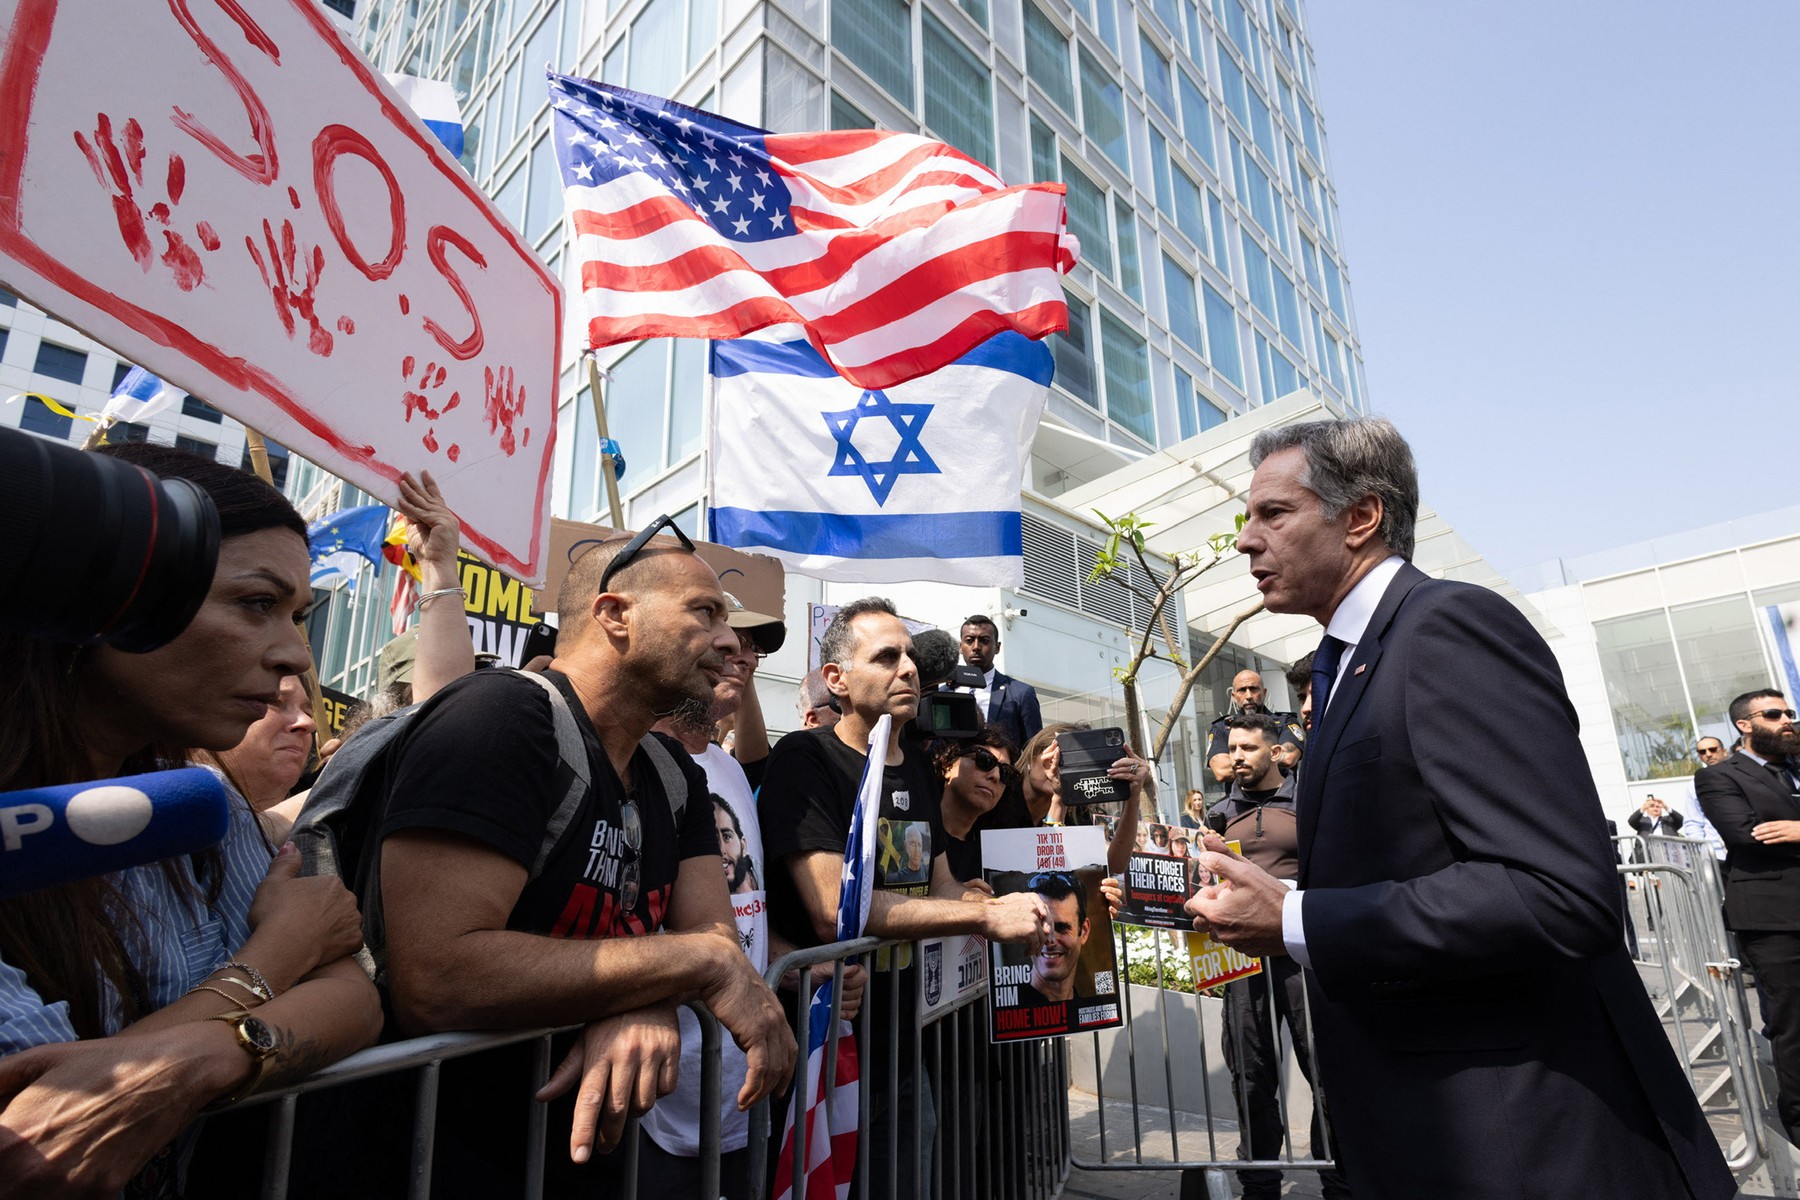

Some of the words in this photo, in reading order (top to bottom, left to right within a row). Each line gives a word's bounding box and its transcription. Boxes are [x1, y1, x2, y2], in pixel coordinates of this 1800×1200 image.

[813, 605, 831, 627] Pr
[591, 819, 625, 858] BNG
[1036, 845, 1055, 857] DROR
[1055, 844, 1065, 856] OR
[583, 848, 620, 890] THM
[1052, 856, 1066, 869] (49)
[1129, 856, 1153, 874] DON'T
[1154, 859, 1184, 877] FORGET
[1129, 872, 1156, 890] THEIR
[1157, 874, 1185, 893] FACES
[995, 964, 1031, 986] BRING
[1194, 951, 1224, 983] FOR
[1222, 947, 1257, 974] YOU
[995, 986, 1019, 1008] HIM
[996, 1008, 1030, 1031] HOME
[1033, 1001, 1067, 1027] NOW!
